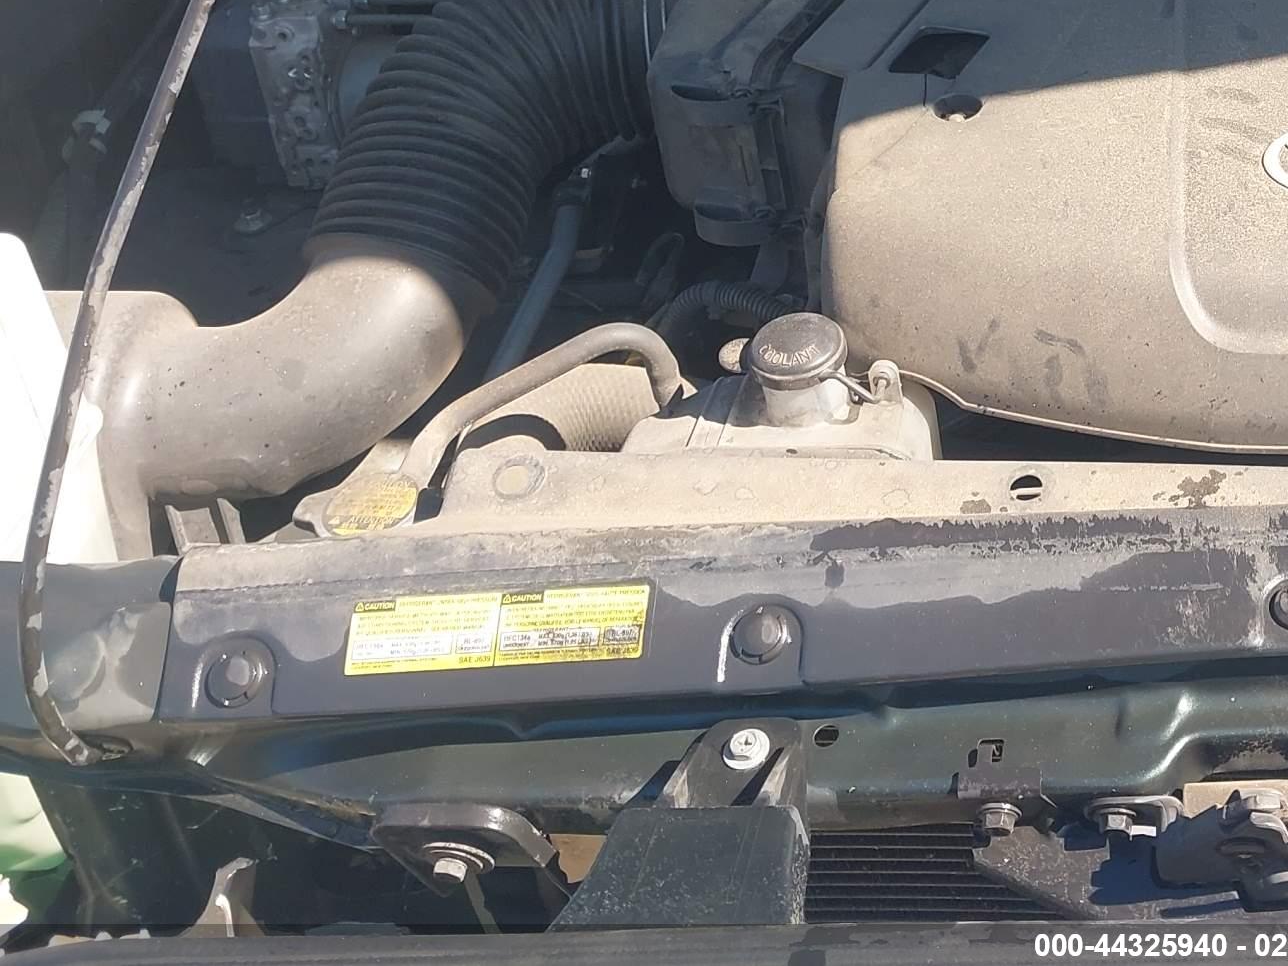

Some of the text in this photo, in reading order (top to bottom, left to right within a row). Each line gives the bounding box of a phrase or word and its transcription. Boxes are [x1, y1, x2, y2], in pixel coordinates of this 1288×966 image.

[758, 343, 820, 367] COOLANT
[512, 593, 542, 603] CAUTION
[364, 602, 395, 611] CAUTION
[458, 656, 472, 664] SAE
